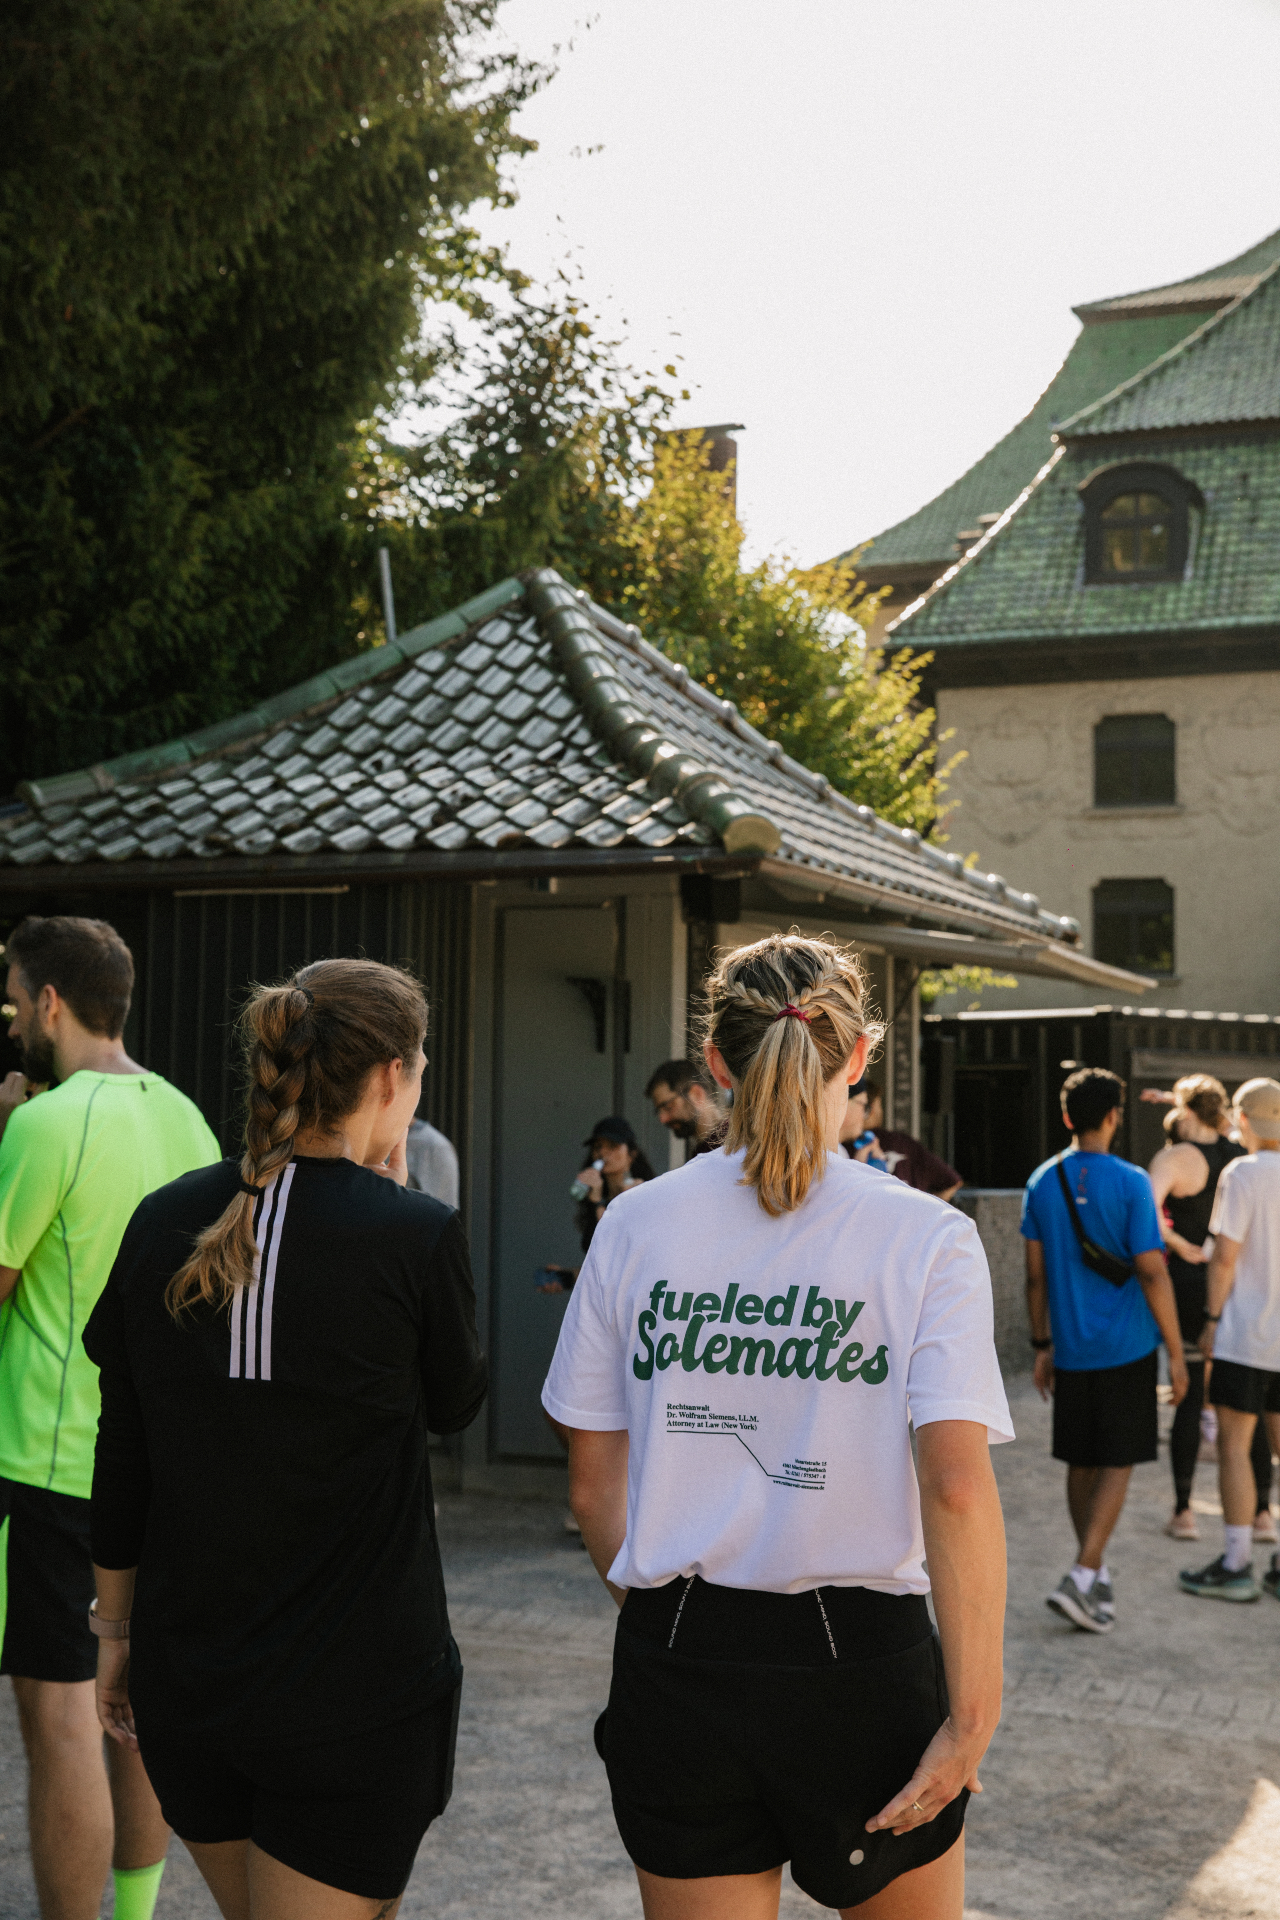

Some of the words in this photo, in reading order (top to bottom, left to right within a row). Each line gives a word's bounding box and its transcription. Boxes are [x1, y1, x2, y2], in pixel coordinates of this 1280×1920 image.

[649, 1279, 800, 1326] fueled
[800, 1285, 866, 1339] by
[633, 1309, 889, 1385] Solemates
[666, 1403, 710, 1411] Rechtsanwalt
[708, 1413, 737, 1421] Siemens,
[666, 1420, 696, 1428] Attorney
[740, 1423, 757, 1431] York)
[814, 1588, 822, 1603] OUND
[824, 1620, 834, 1642] SOUND
[668, 1628, 676, 1648] SOUND
